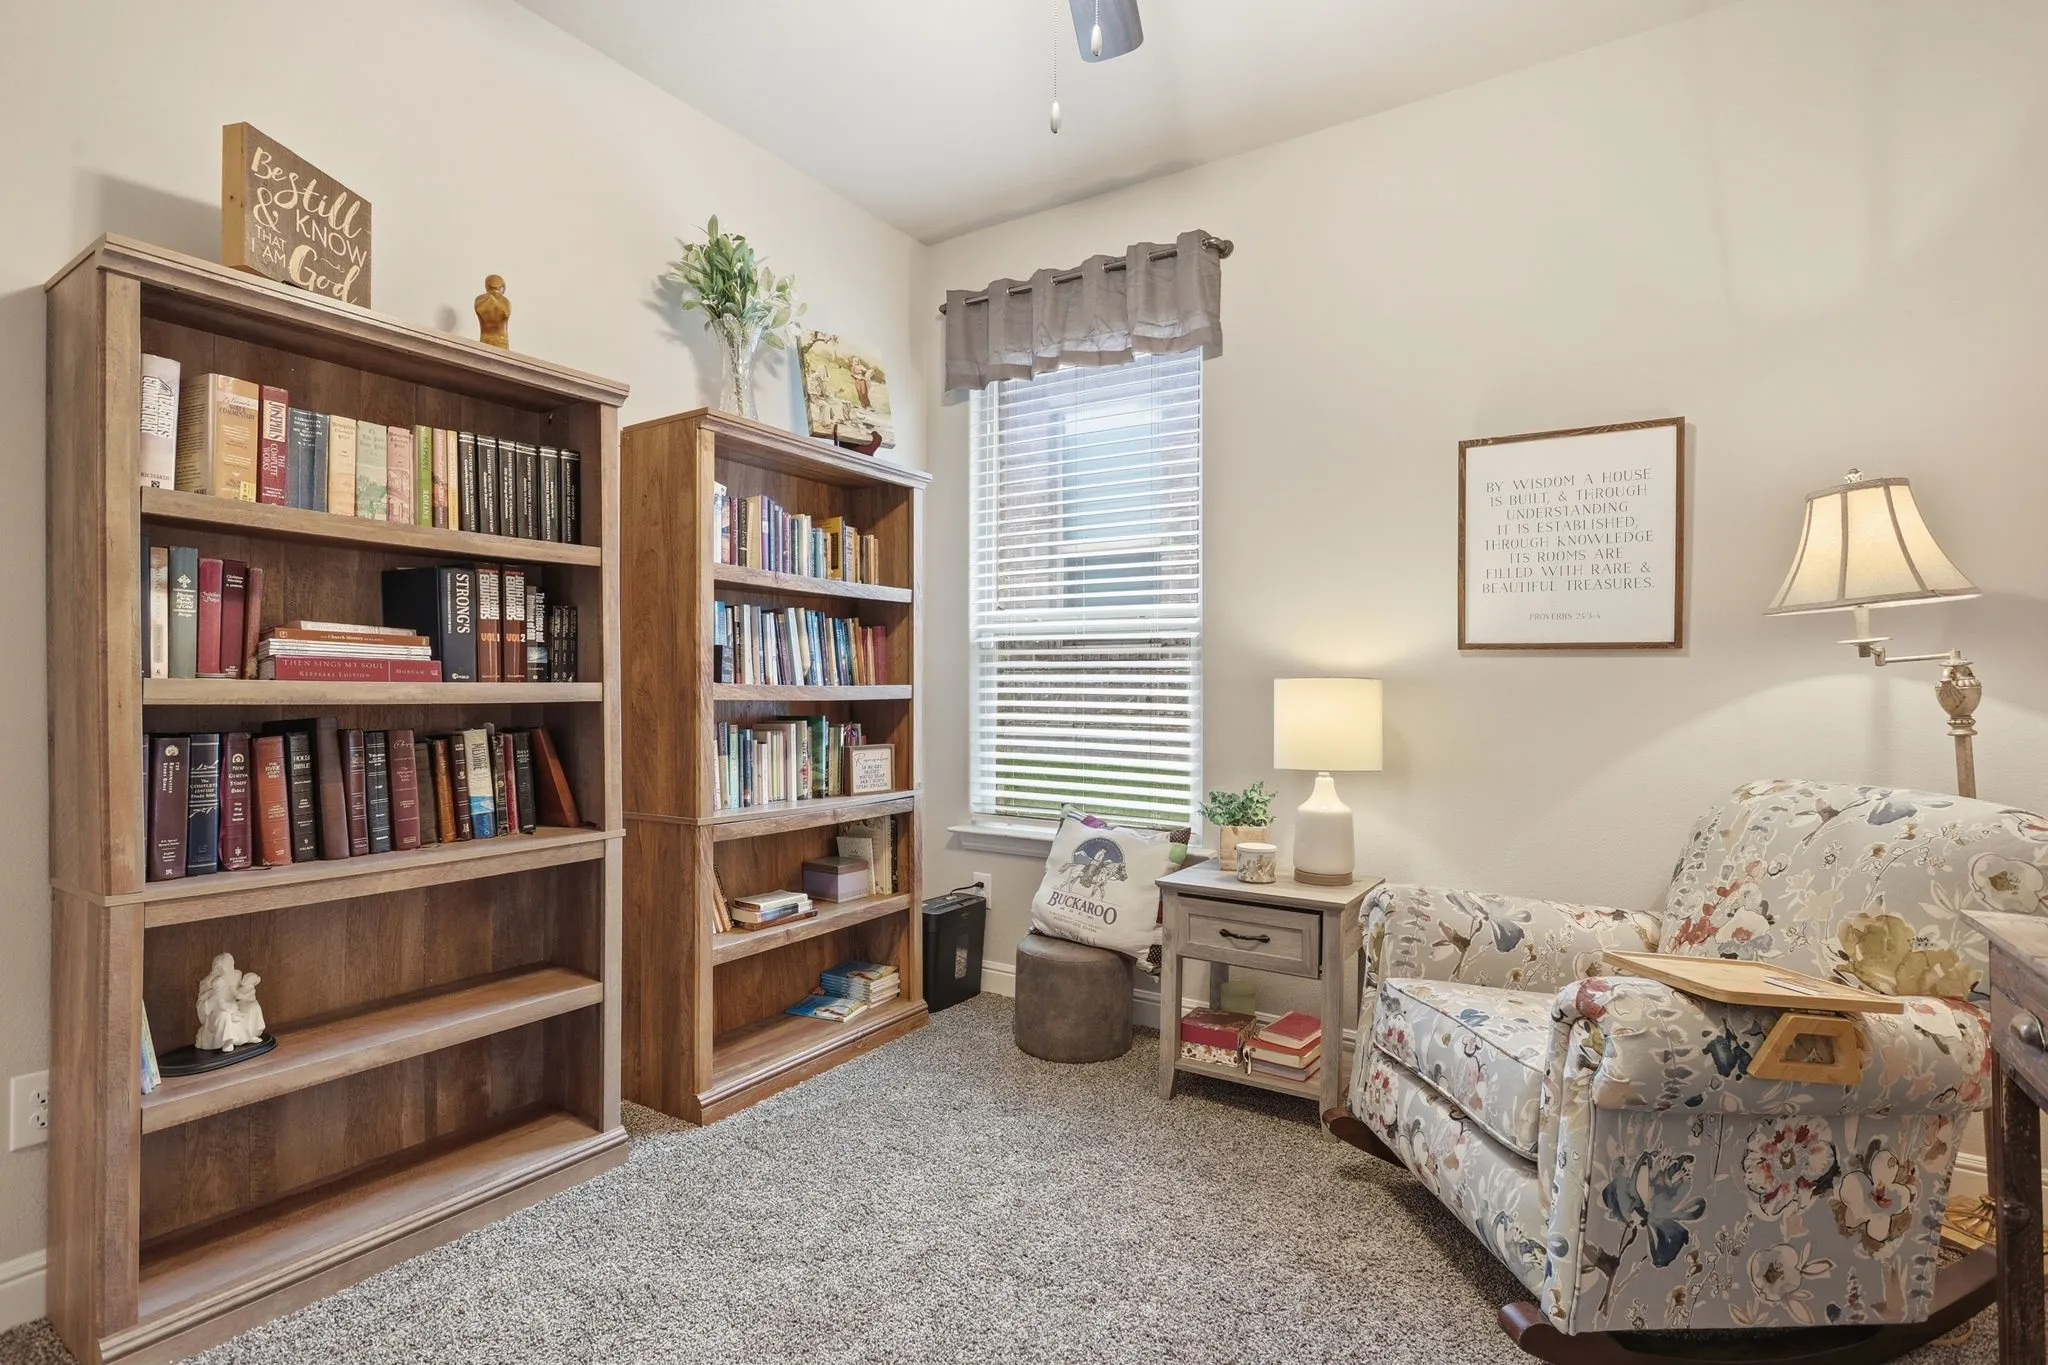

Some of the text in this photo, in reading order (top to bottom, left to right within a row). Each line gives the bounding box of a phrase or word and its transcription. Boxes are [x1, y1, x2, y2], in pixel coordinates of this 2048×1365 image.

[251, 146, 362, 238] Be Still
[253, 187, 282, 233] &
[255, 225, 287, 250] THAT
[295, 209, 367, 267] KNOW
[262, 246, 286, 268] AM
[288, 245, 360, 304] God
[268, 401, 285, 442] JOSEPHUS
[1486, 468, 1652, 493] BY WISDOM A HOUSE
[1490, 484, 1648, 508] IS BUILT, & THROUGH
[1506, 501, 1628, 520] UNDERSTANDING
[1484, 530, 1654, 551] THROUGH KNOWLEDGE
[1497, 524, 1509, 536] IT
[1517, 523, 1530, 534] IS
[1510, 547, 1624, 564] ITS ROOMS ARE
[1486, 561, 1651, 580] FILLED WITH RARE &
[480, 574, 490, 620] EDWARDS
[489, 572, 500, 620] JONATHAN
[506, 576, 516, 620] EDWARDS
[515, 575, 525, 620] JONATHAN
[1482, 577, 1656, 594] BEAUTIFUL TREASURES.
[455, 573, 471, 634] STRONG'S
[1529, 612, 1573, 621] PROVERBS
[283, 659, 311, 667] THEN
[313, 660, 341, 668] SINGS
[1047, 891, 1117, 925] BUCKAROO
